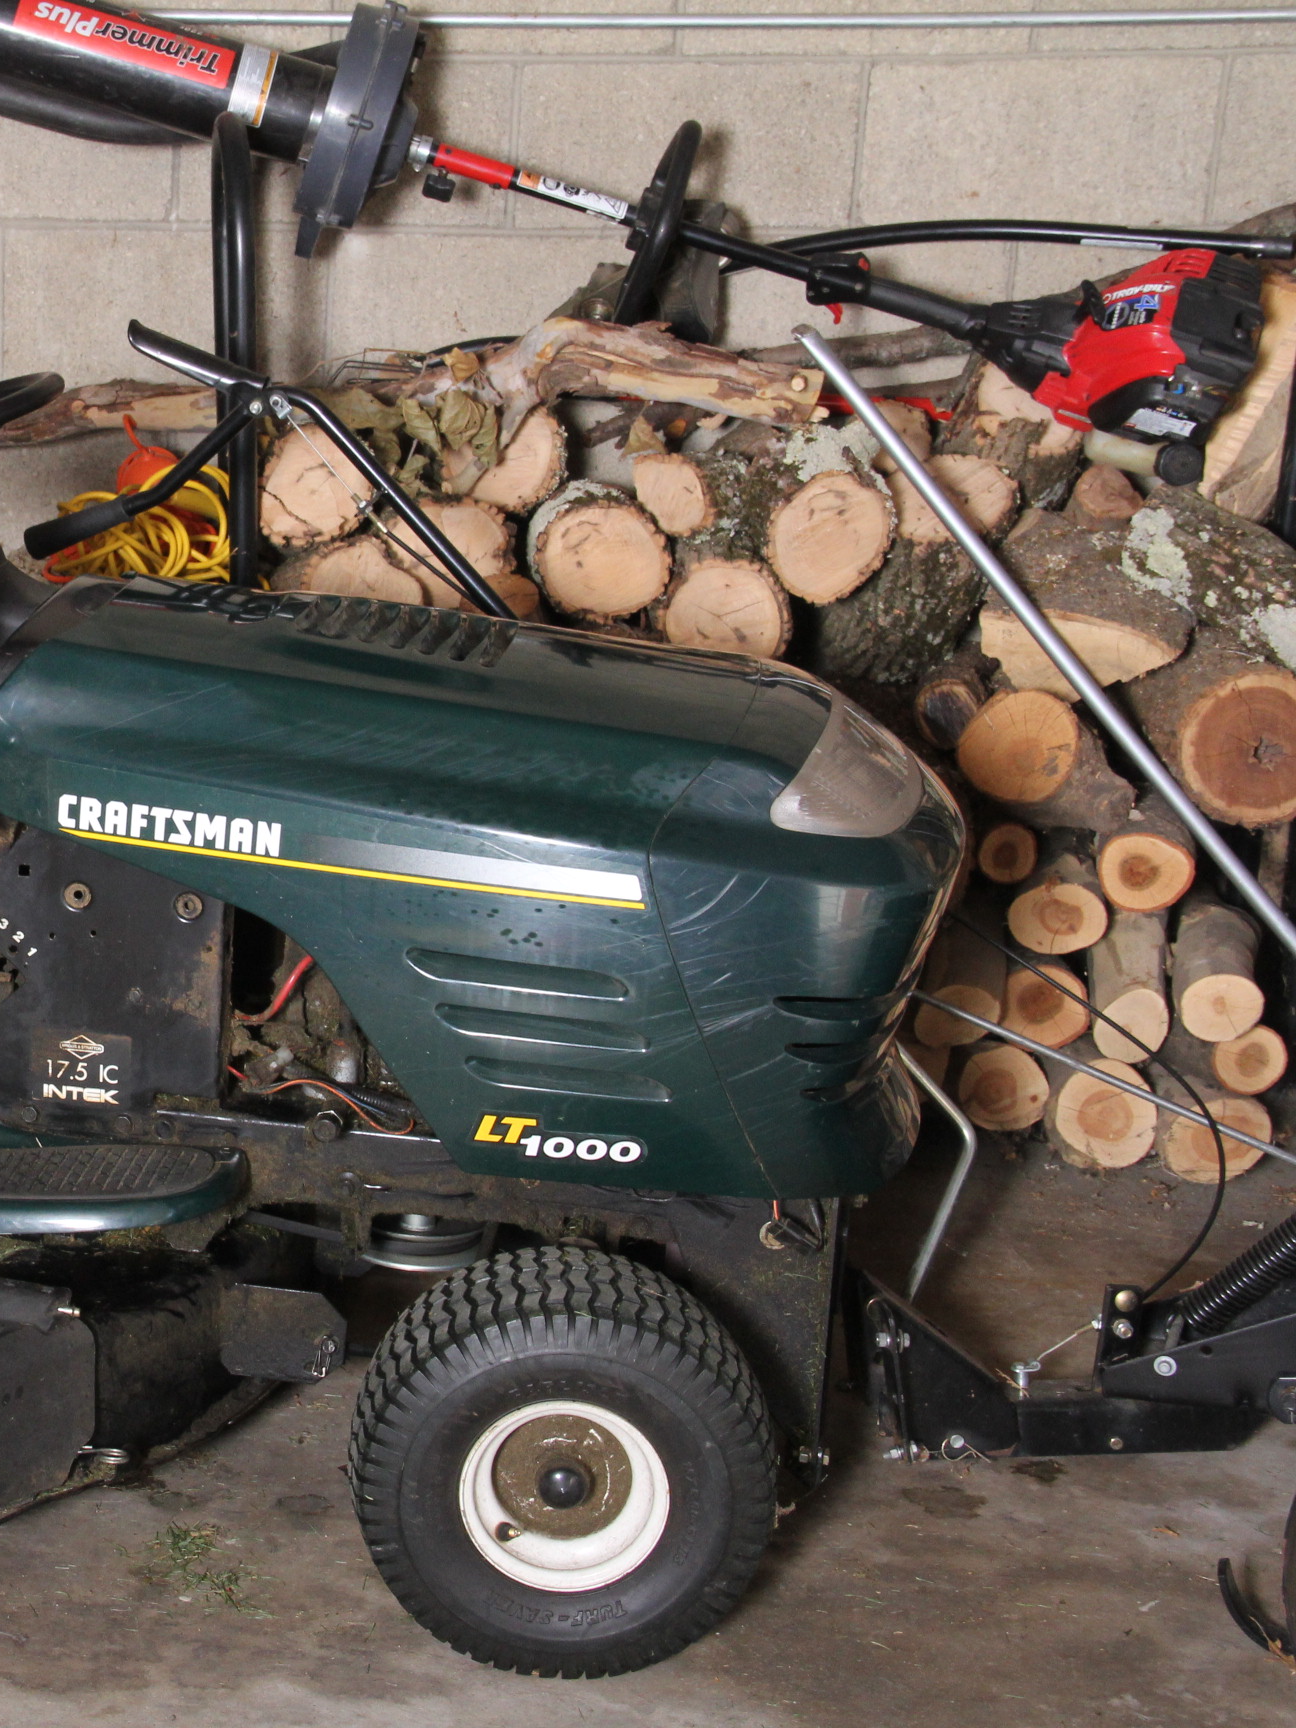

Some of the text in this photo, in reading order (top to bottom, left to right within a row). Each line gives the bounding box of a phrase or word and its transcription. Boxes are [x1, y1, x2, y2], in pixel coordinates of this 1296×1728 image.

[34, 1, 219, 76] TrimmerPlus
[57, 793, 282, 858] CRAFTSMAN
[11, 930, 25, 943] 2
[26, 946, 38, 957] 1
[46, 1059, 119, 1085] 17.5 IC
[43, 1084, 120, 1105] INTEK
